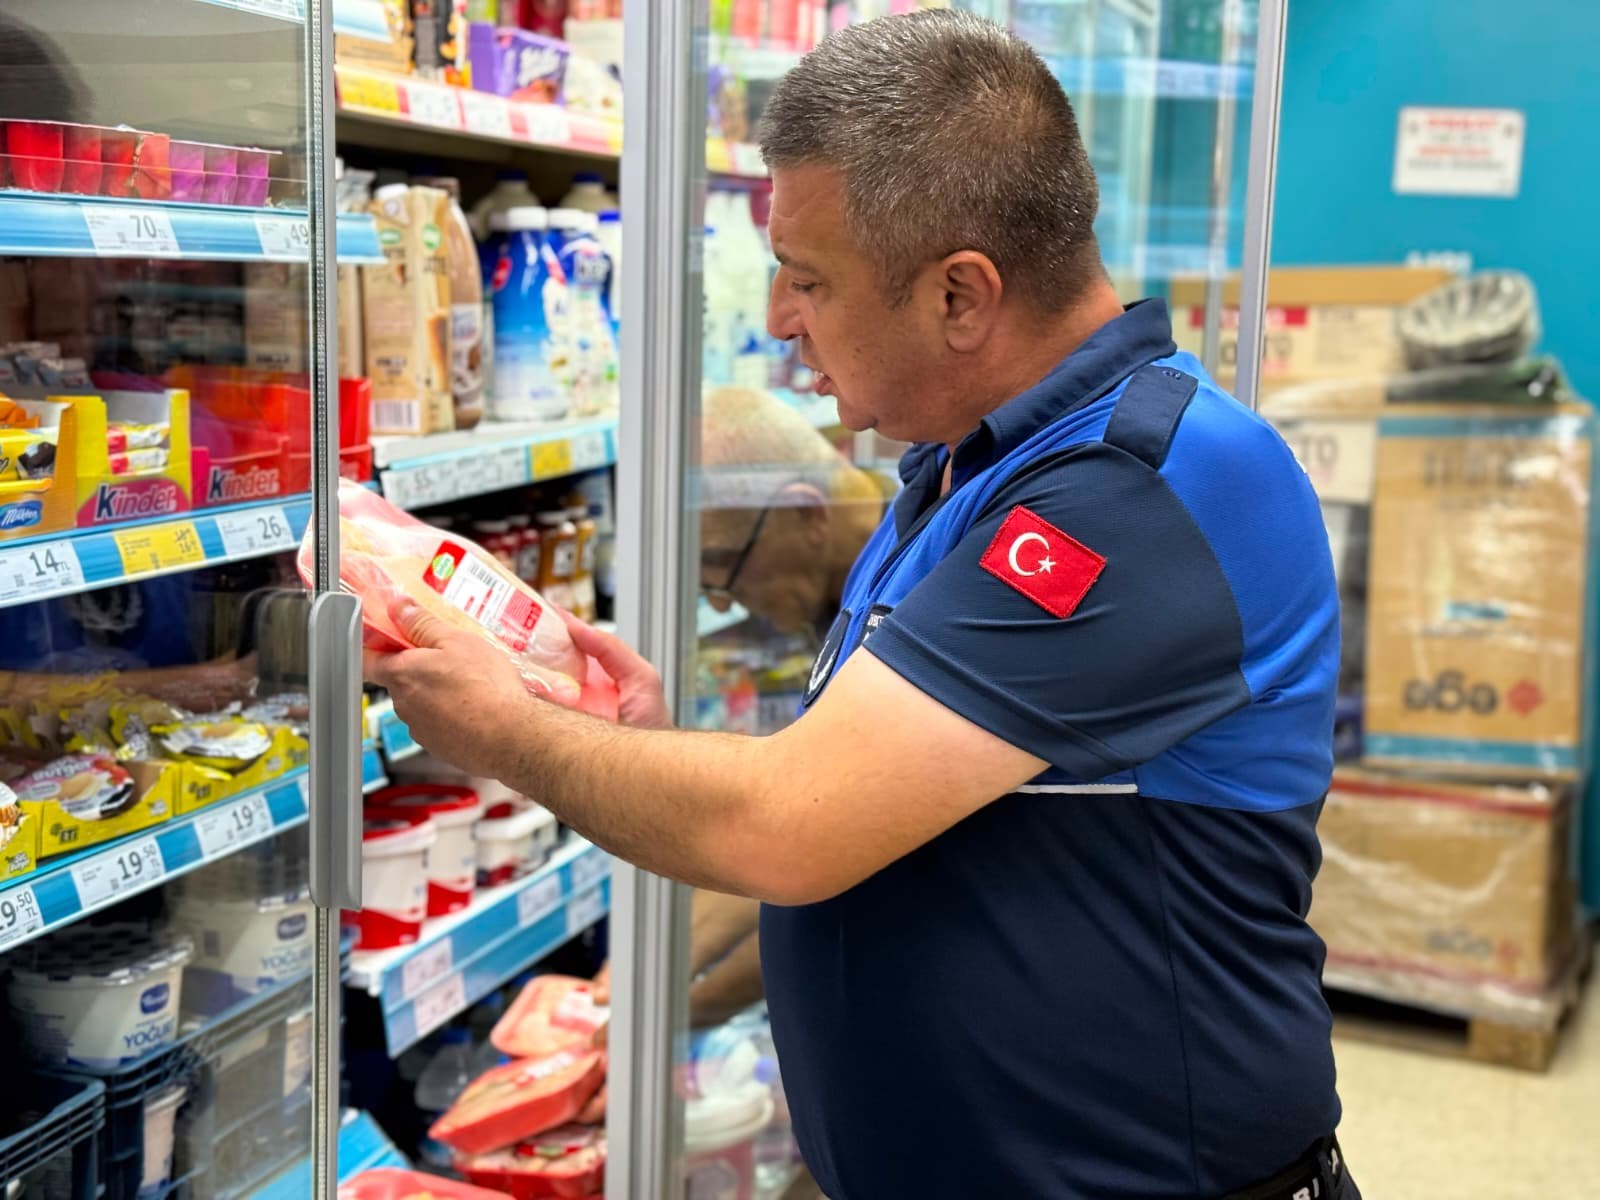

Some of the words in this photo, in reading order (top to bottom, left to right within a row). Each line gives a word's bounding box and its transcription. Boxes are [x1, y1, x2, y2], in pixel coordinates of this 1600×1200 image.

[129, 215, 157, 238] 70
[208, 467, 280, 502] Kinder
[94, 483, 178, 521] Kinder
[257, 515, 282, 540] 26
[29, 548, 59, 576] 14
[25, 906, 38, 919] TL
